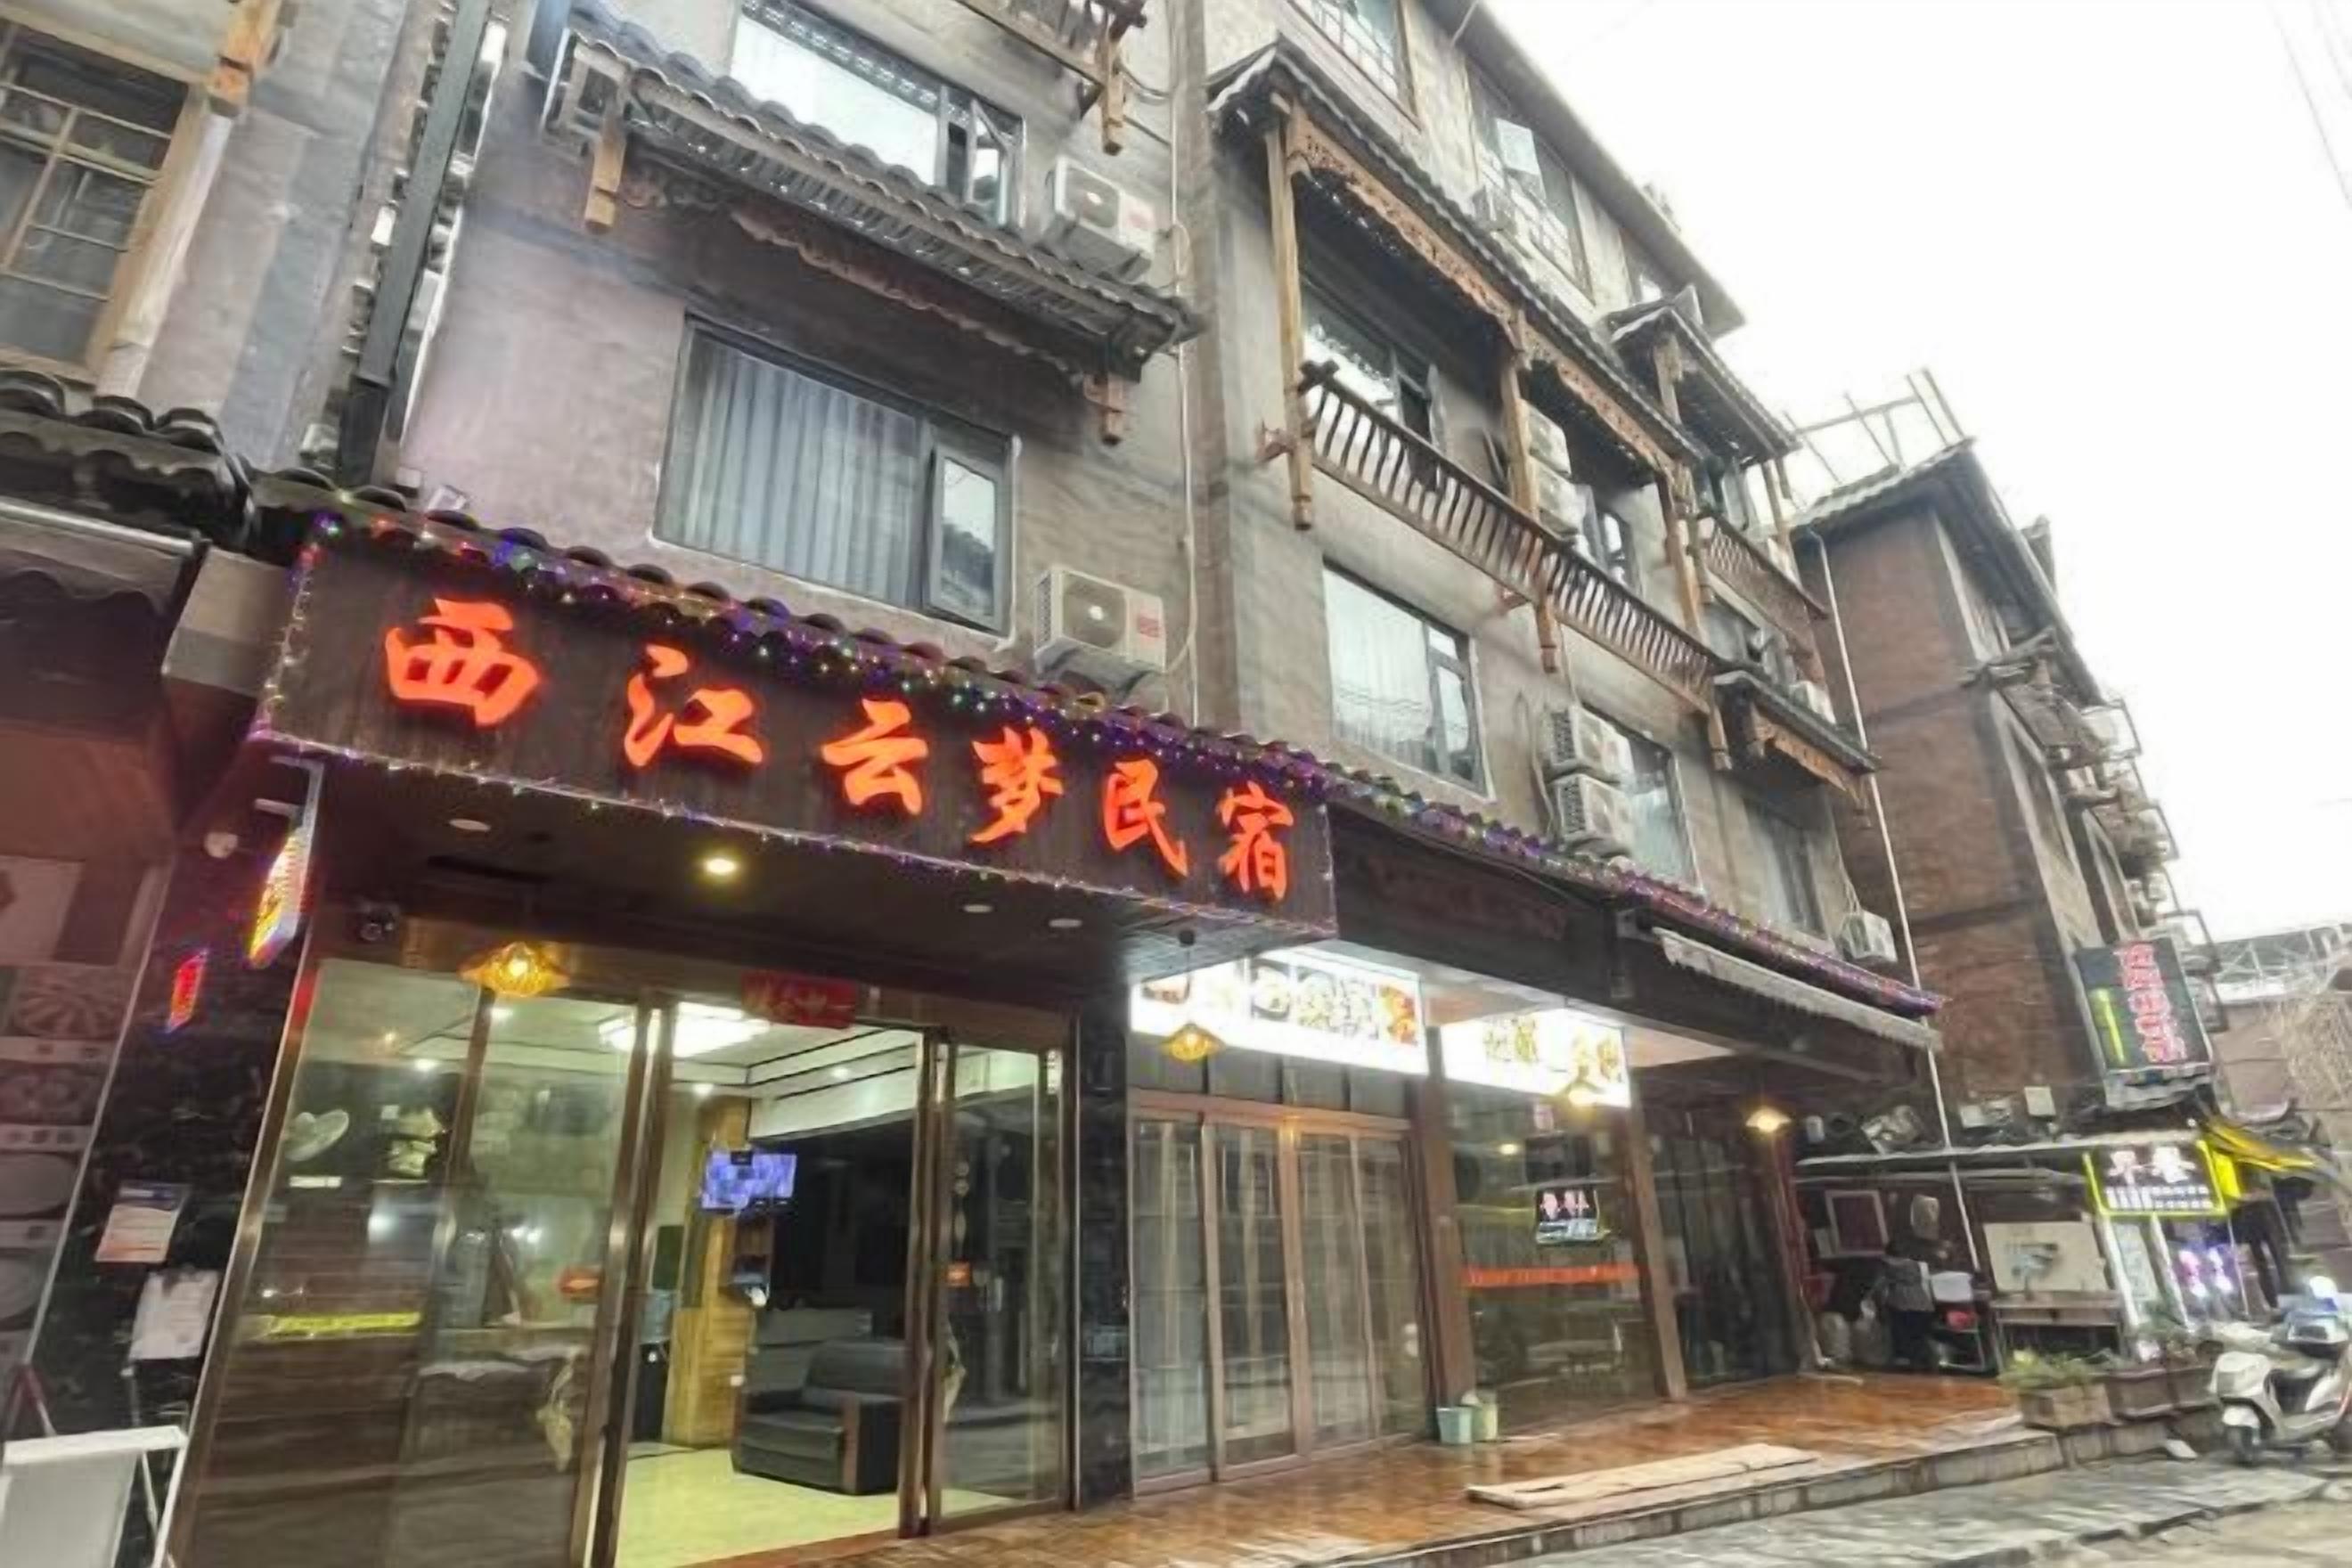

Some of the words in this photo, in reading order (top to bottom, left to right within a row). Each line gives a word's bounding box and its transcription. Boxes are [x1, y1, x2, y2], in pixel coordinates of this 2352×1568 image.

[385, 598, 1294, 899] 西江云梦民宿
